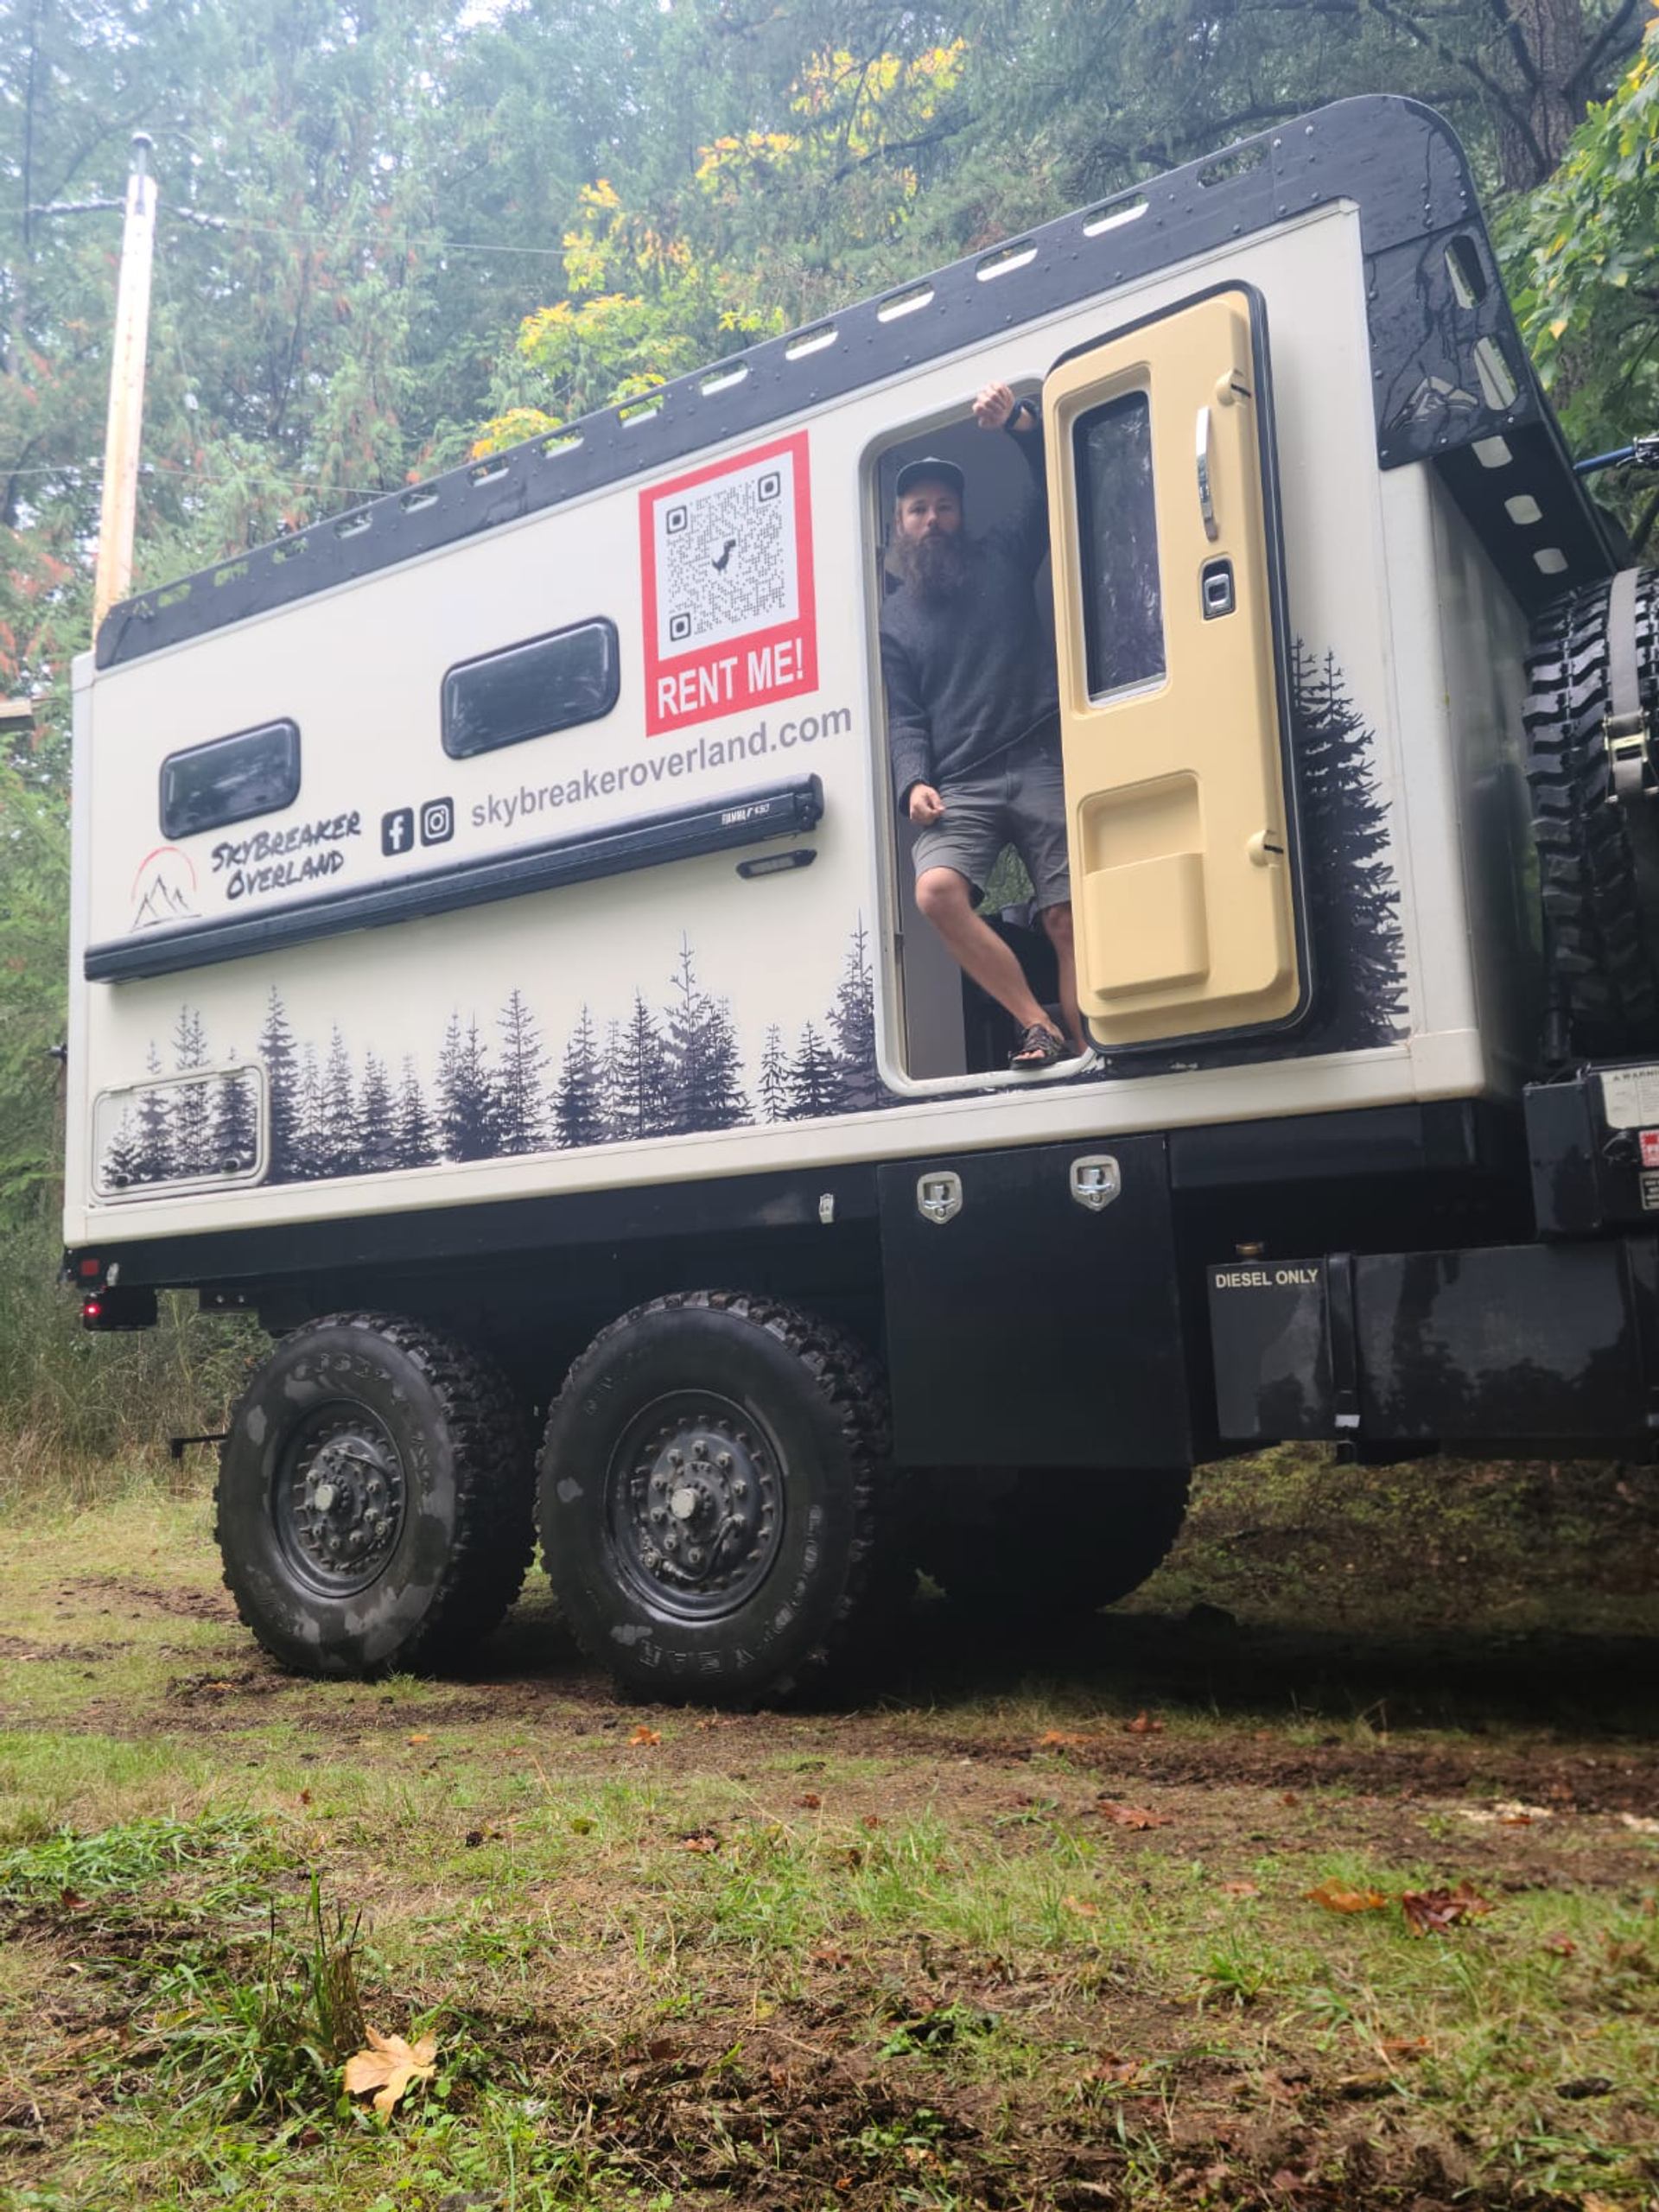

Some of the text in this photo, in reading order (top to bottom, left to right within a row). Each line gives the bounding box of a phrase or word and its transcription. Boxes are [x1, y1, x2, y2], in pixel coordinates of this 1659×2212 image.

[658, 638, 804, 719] RENT ME!
[471, 707, 853, 828] skybreakeroverland.com
[1215, 1268, 1318, 1288] DIESEL ONLY
